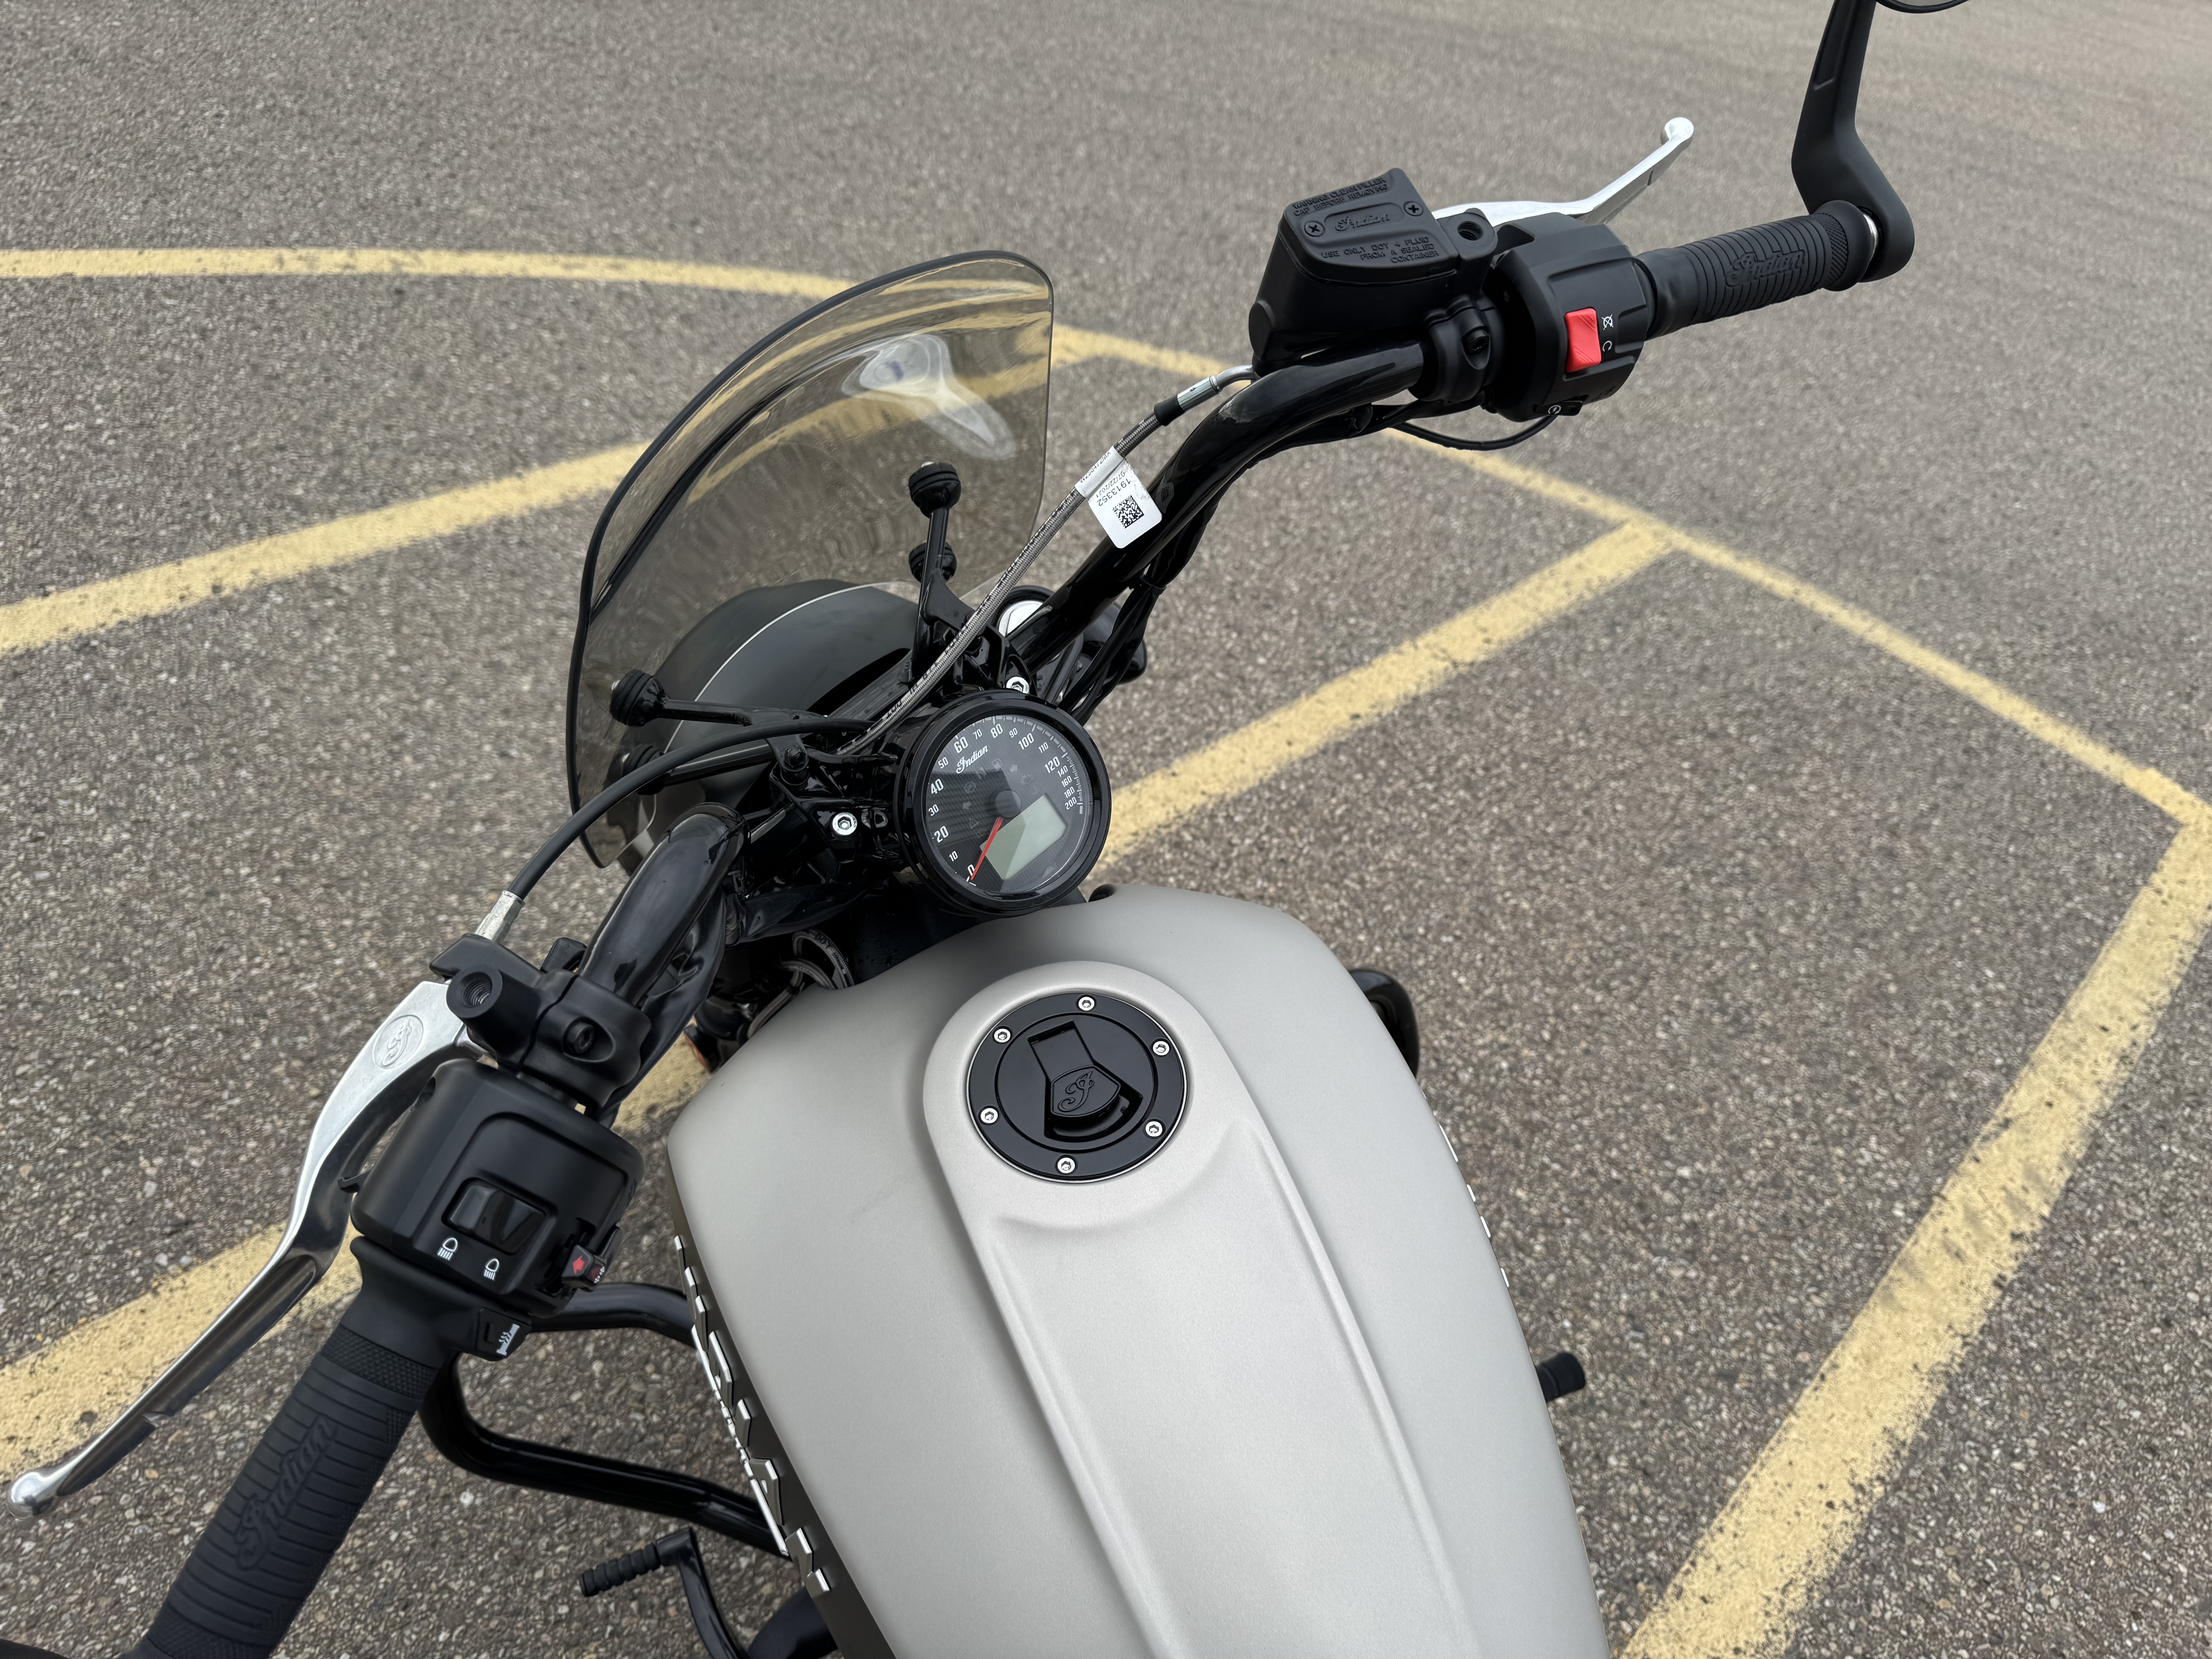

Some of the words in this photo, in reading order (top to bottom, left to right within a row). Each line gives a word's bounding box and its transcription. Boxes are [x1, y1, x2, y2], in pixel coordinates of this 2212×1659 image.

[1331, 185, 1356, 198] CLEAN
[1357, 177, 1386, 190] FILLER
[1293, 207, 1310, 216] CAP
[1313, 197, 1345, 210] BEFORE
[1348, 184, 1388, 200] REMOVING
[1335, 214, 1391, 231] Indian
[1321, 250, 1340, 258] USE
[1343, 247, 1365, 255] ONLY
[1371, 243, 1389, 251] DOT
[1405, 236, 1430, 246] FLUID
[1360, 251, 1386, 260] FROM
[1401, 243, 1435, 254] SEALED
[1391, 250, 1439, 263] CONTAINER
[1725, 250, 1805, 287] Indian
[1097, 478, 1131, 506] 1913352
[973, 729, 982, 740] 70
[991, 723, 1003, 738] 80
[1009, 728, 1018, 738] 90
[954, 736, 969, 754] 60
[1018, 733, 1034, 750] 100
[1038, 742, 1049, 753] 110
[938, 757, 949, 769] 50
[956, 745, 989, 774] Indian
[1044, 756, 1060, 773] 120
[1057, 765, 1068, 777] 140
[931, 778, 944, 794] 40
[1061, 775, 1072, 787] 160
[1064, 786, 1075, 799] 180
[928, 804, 939, 816] 30
[1065, 796, 1077, 810] 200
[934, 826, 949, 843] 20
[949, 851, 958, 862] 10
